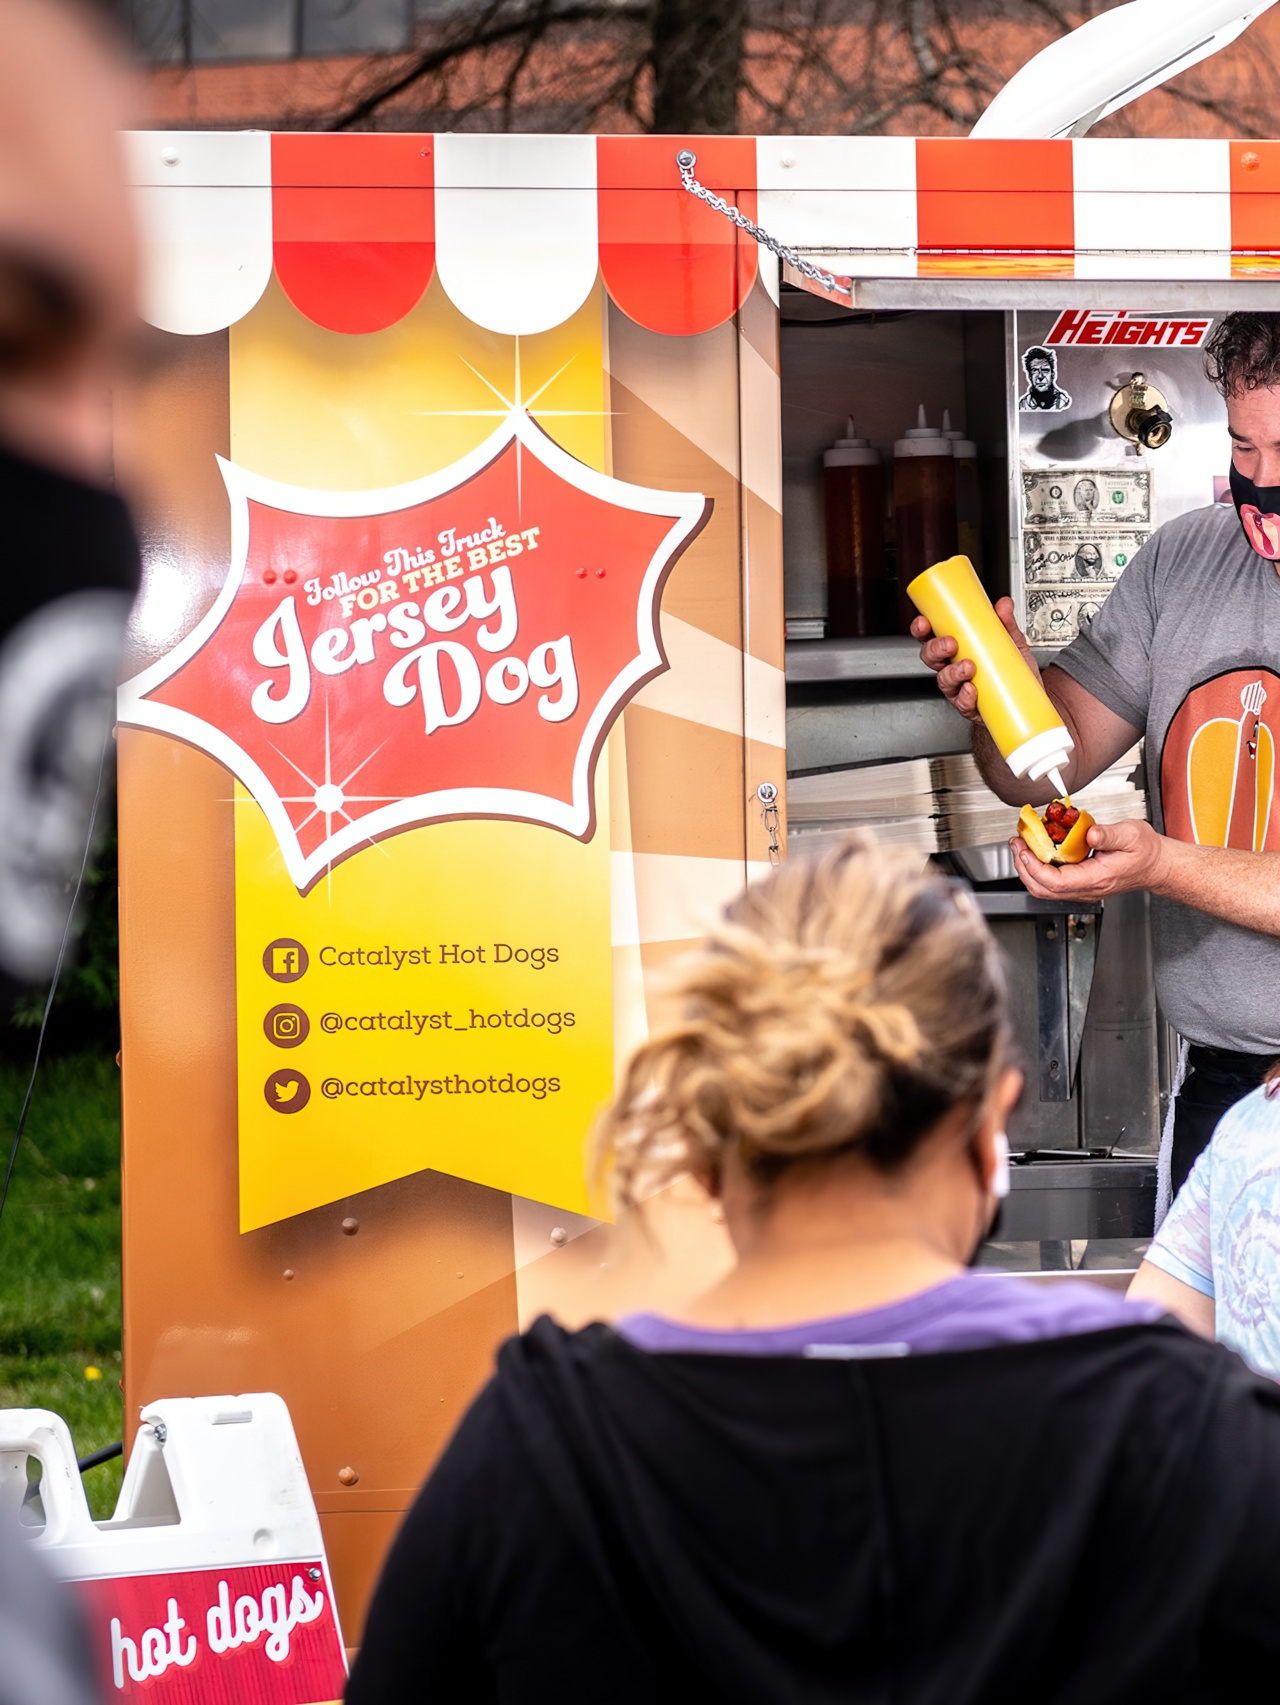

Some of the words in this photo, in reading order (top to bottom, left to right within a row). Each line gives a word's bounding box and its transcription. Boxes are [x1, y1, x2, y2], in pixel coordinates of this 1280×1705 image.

[304, 571, 381, 606] Follow
[383, 547, 436, 577] This
[437, 517, 506, 557] Truck
[338, 580, 400, 618] FOR
[402, 556, 464, 594] THE
[466, 527, 540, 571] BEST
[251, 565, 519, 724] Jersey
[382, 634, 579, 736] Dog
[319, 946, 431, 971] Catalyst
[439, 945, 486, 965] Hot
[493, 944, 560, 970] Dogs
[320, 1009, 576, 1035] @catalyst_hotdogs
[321, 1074, 561, 1101] @catalysthotdogs
[111, 1598, 197, 1689] hot
[206, 1575, 324, 1662] dogs
